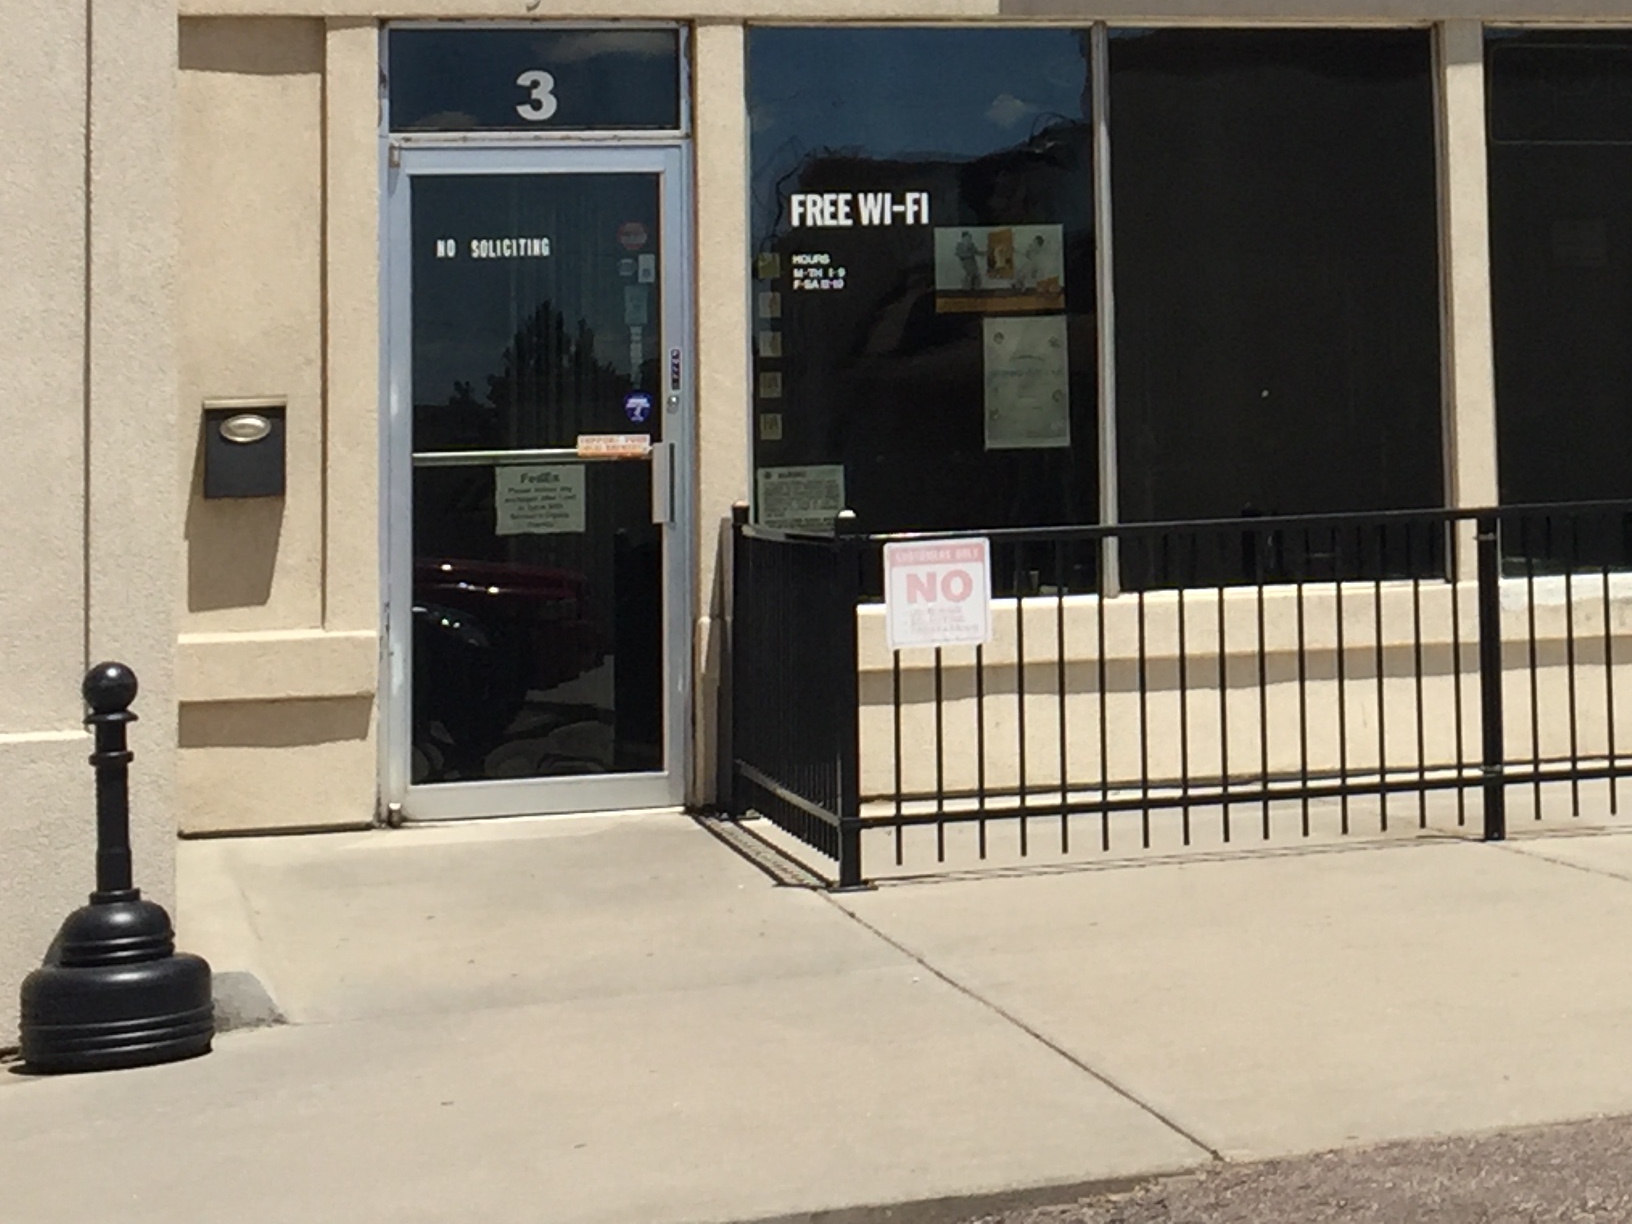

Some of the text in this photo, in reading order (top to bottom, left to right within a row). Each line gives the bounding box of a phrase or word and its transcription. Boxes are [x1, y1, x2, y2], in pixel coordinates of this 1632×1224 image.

[515, 70, 558, 122] 3
[790, 192, 930, 227] FREE WI-FI
[436, 237, 551, 259] NO SOLICITING
[792, 253, 831, 265] HOURS
[905, 569, 974, 604] NO
